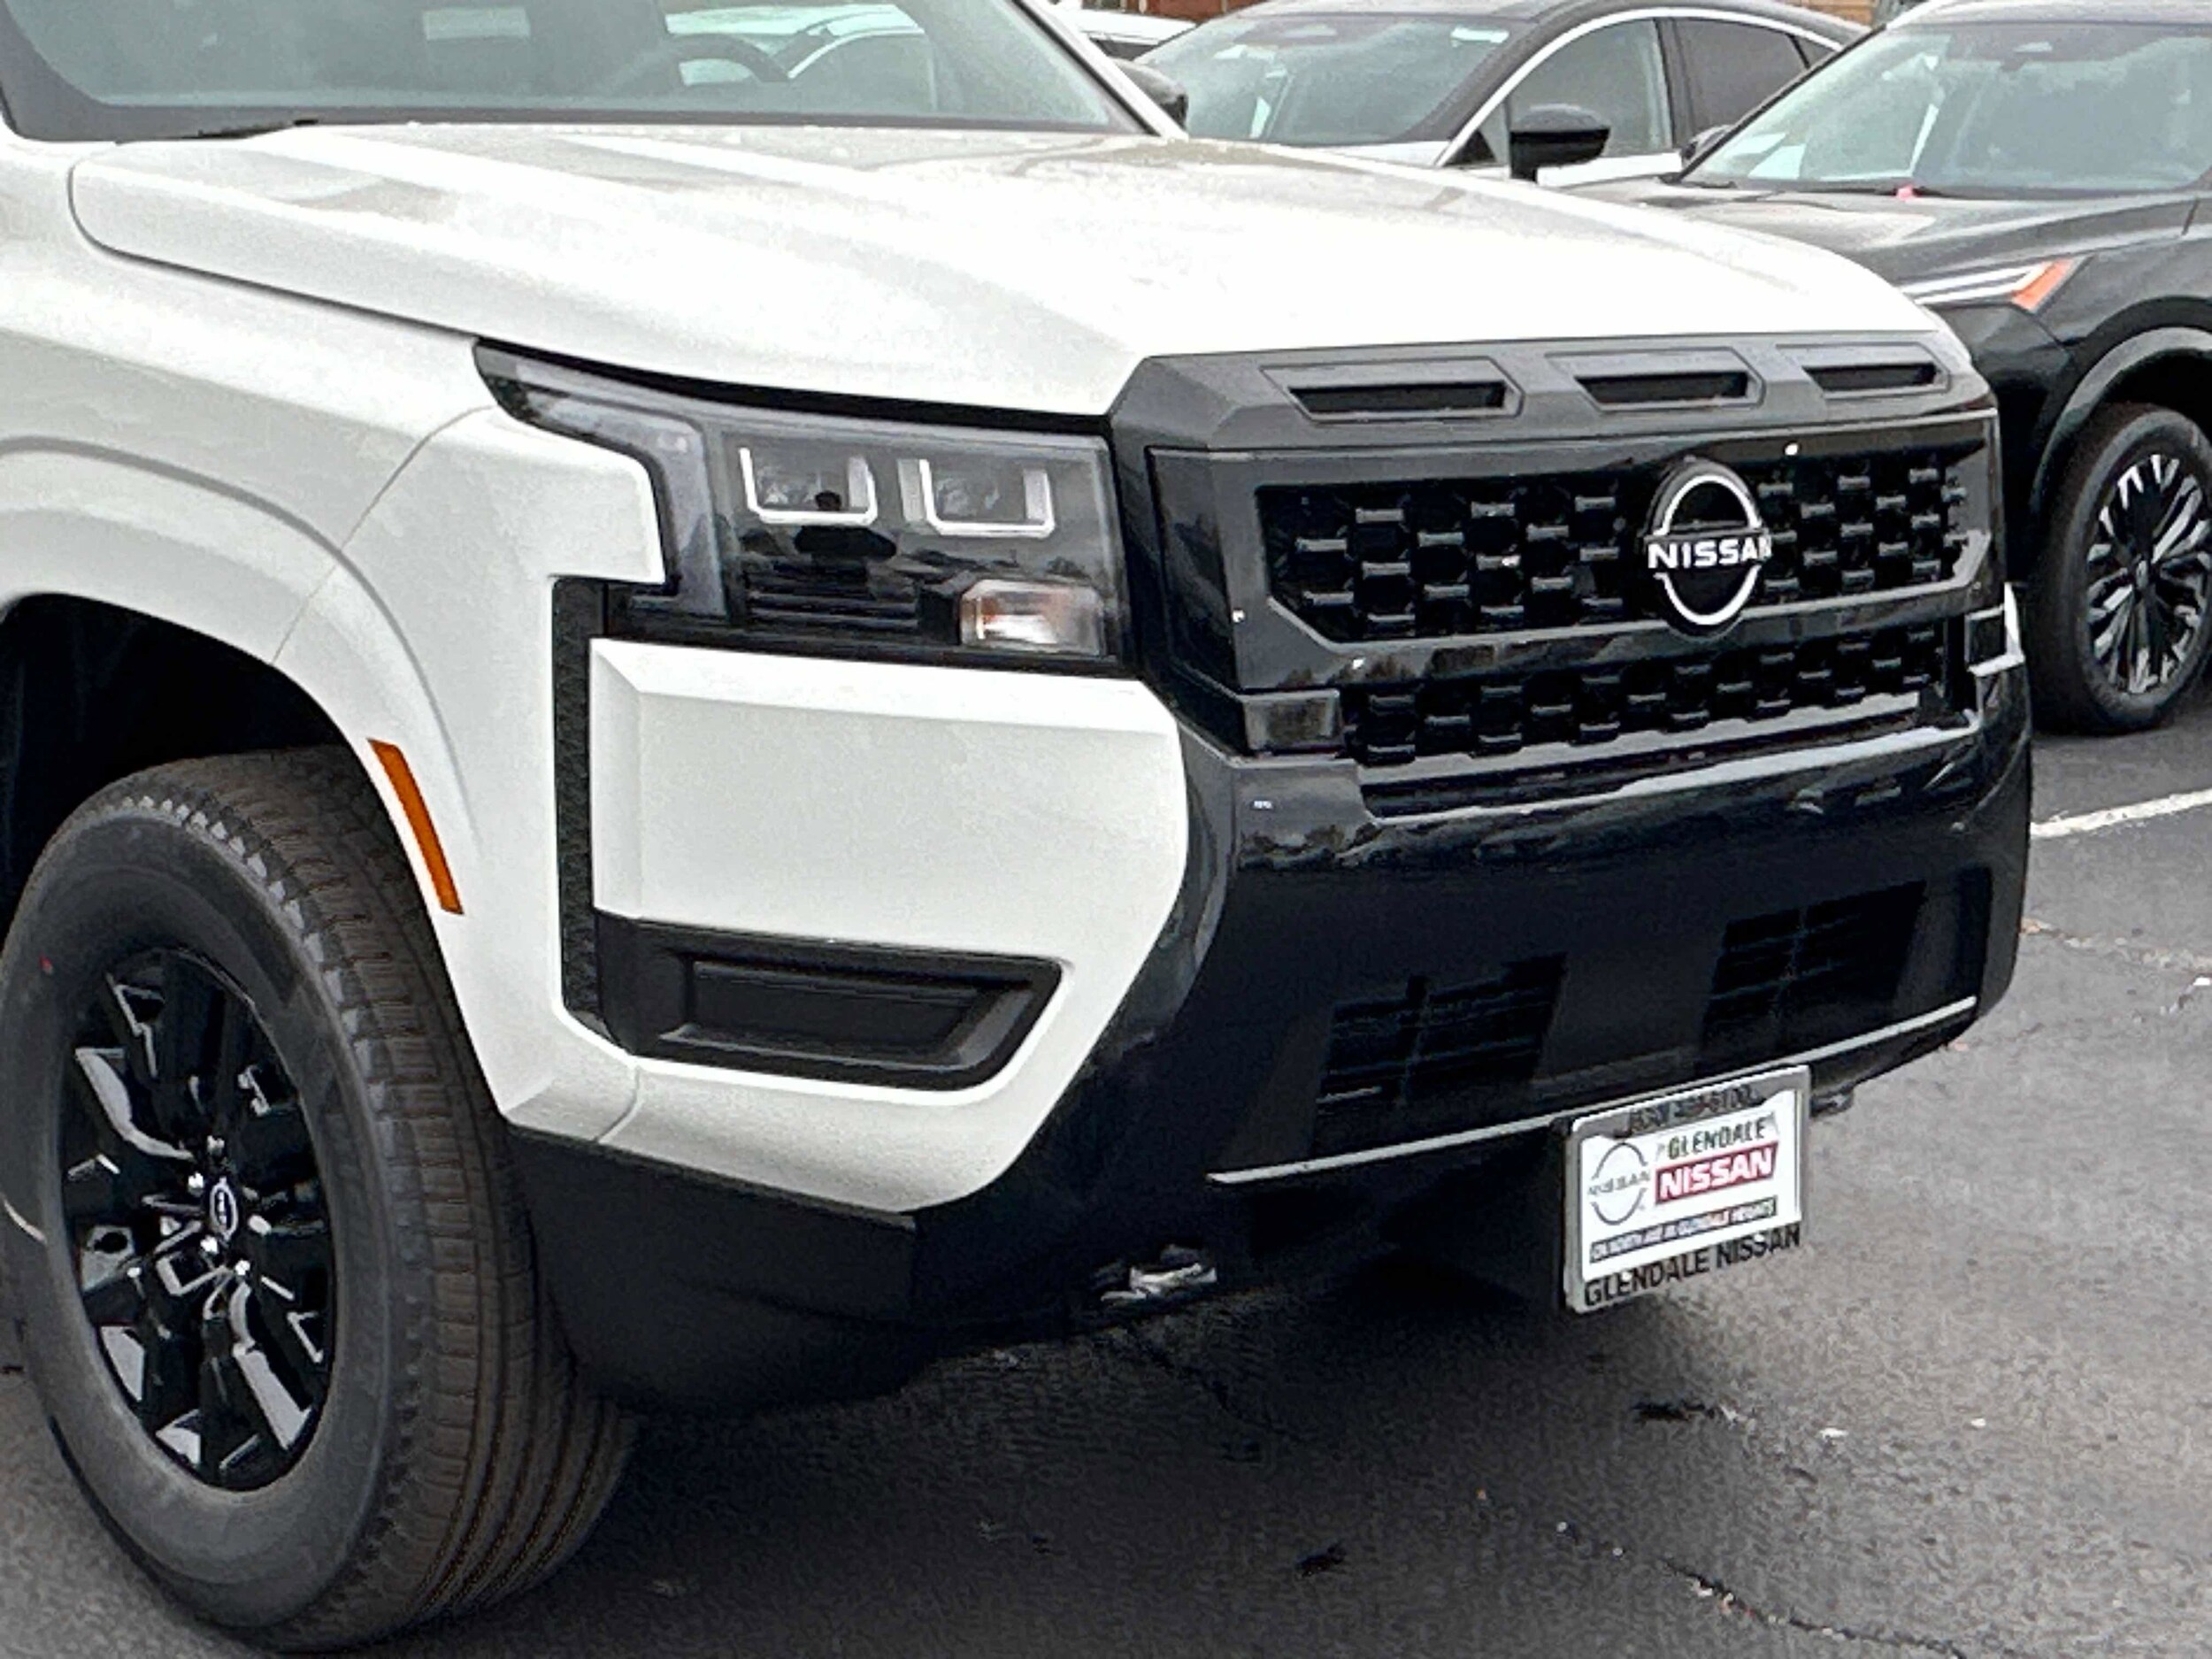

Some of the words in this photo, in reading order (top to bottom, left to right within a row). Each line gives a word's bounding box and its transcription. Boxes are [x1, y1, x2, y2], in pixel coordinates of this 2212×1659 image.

[1647, 536, 1771, 569] NISSAN
[1667, 1117, 1765, 1161] GLENDALE
[1660, 1148, 1772, 1200] NISSAN
[1585, 1246, 1709, 1306] GLENDALE
[1716, 1224, 1800, 1269] NISSAN
